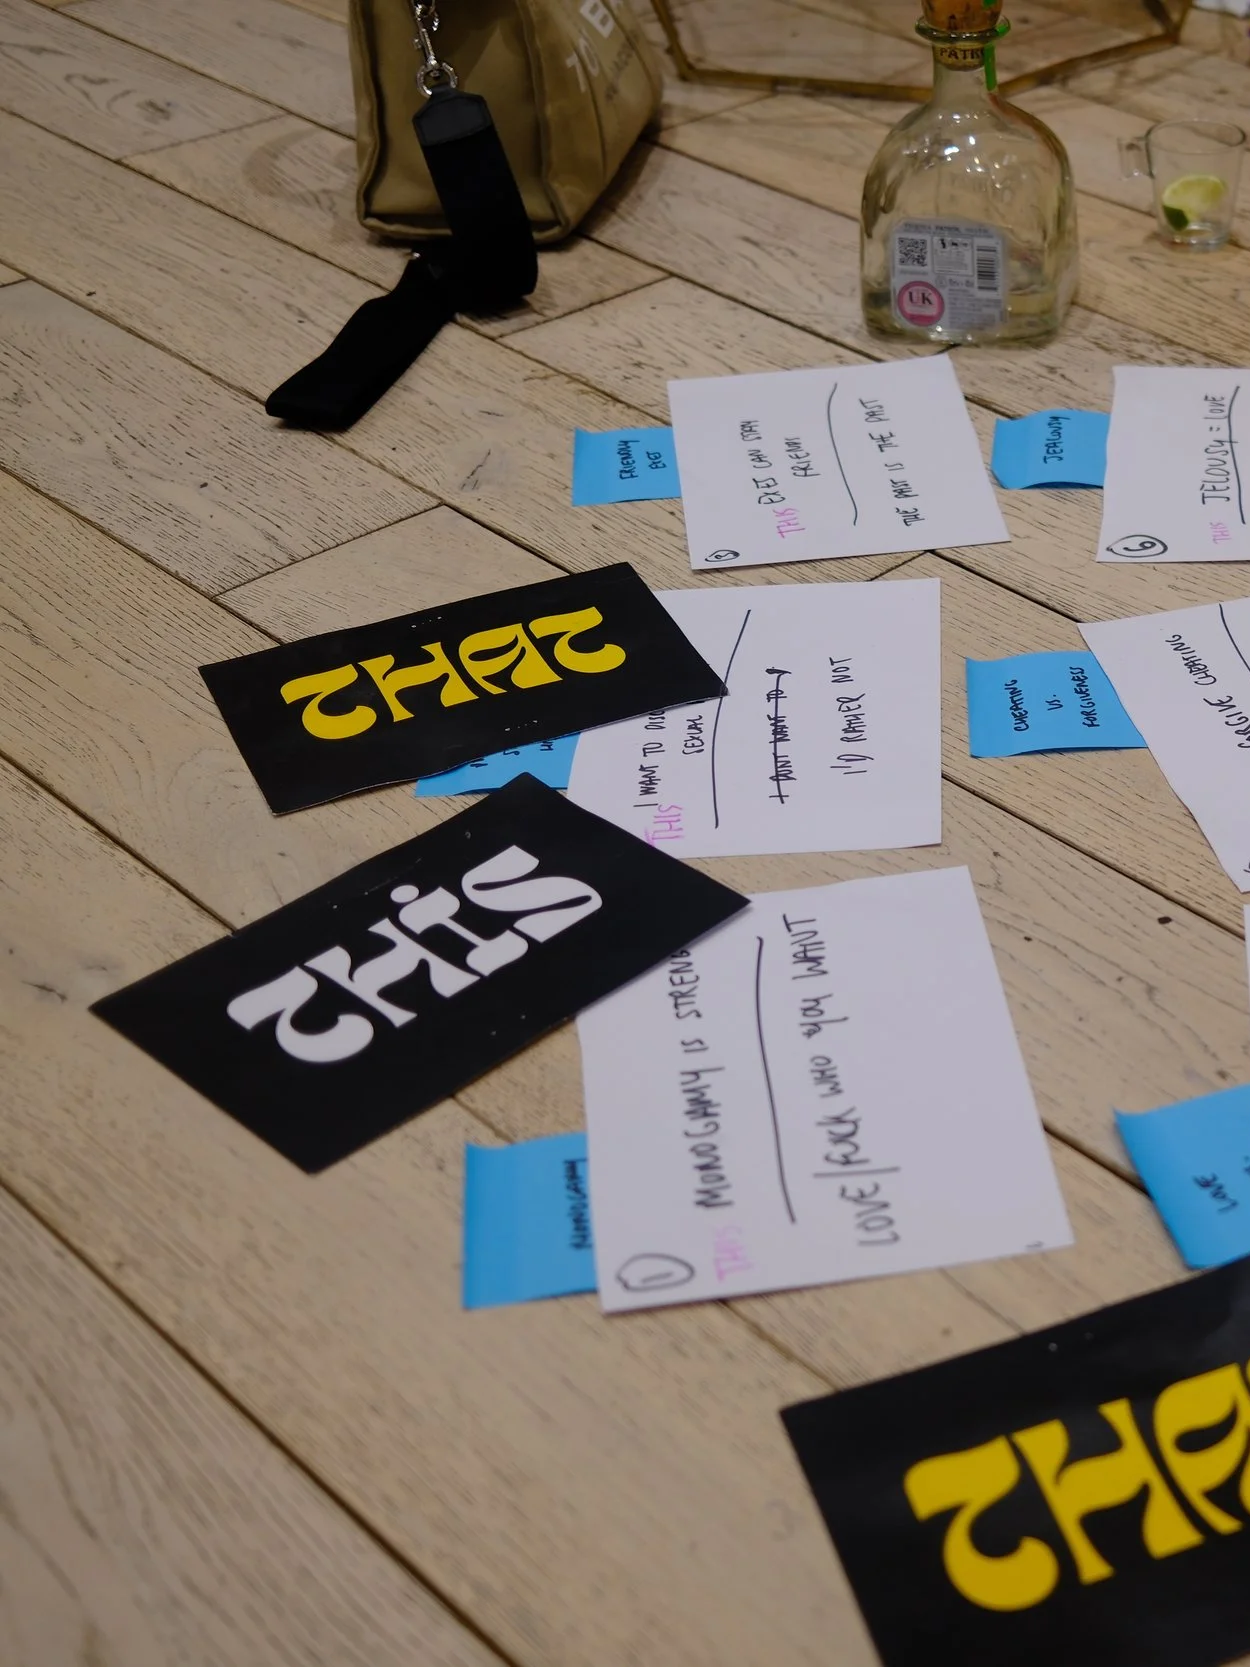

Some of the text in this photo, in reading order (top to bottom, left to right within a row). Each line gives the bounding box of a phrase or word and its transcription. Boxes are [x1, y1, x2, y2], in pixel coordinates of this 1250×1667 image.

[908, 291, 933, 306] UK
[1203, 394, 1229, 420] LOVE
[740, 420, 763, 442] STAY
[748, 449, 773, 469] CAN
[858, 398, 925, 527] THE PAST IS THE PAST
[773, 507, 806, 539] THIS
[1210, 522, 1231, 544] THIS
[829, 656, 854, 683] NOT
[1165, 634, 1217, 686] CHEATING
[1004, 679, 1029, 731] CHEATING
[1069, 666, 1100, 728] FORGIVENESS
[682, 714, 705, 755] SEXUAL
[836, 693, 866, 743] RATHER
[642, 742, 666, 757] TO
[638, 764, 661, 796] WANT
[644, 804, 684, 847] THIS
[782, 914, 829, 980] WANT
[680, 1038, 710, 1054] IS
[810, 1055, 844, 1098] WHO
[679, 1066, 735, 1208] MONOGAMY
[1192, 1172, 1239, 1213] LOVE
[714, 1224, 757, 1284] THIS
